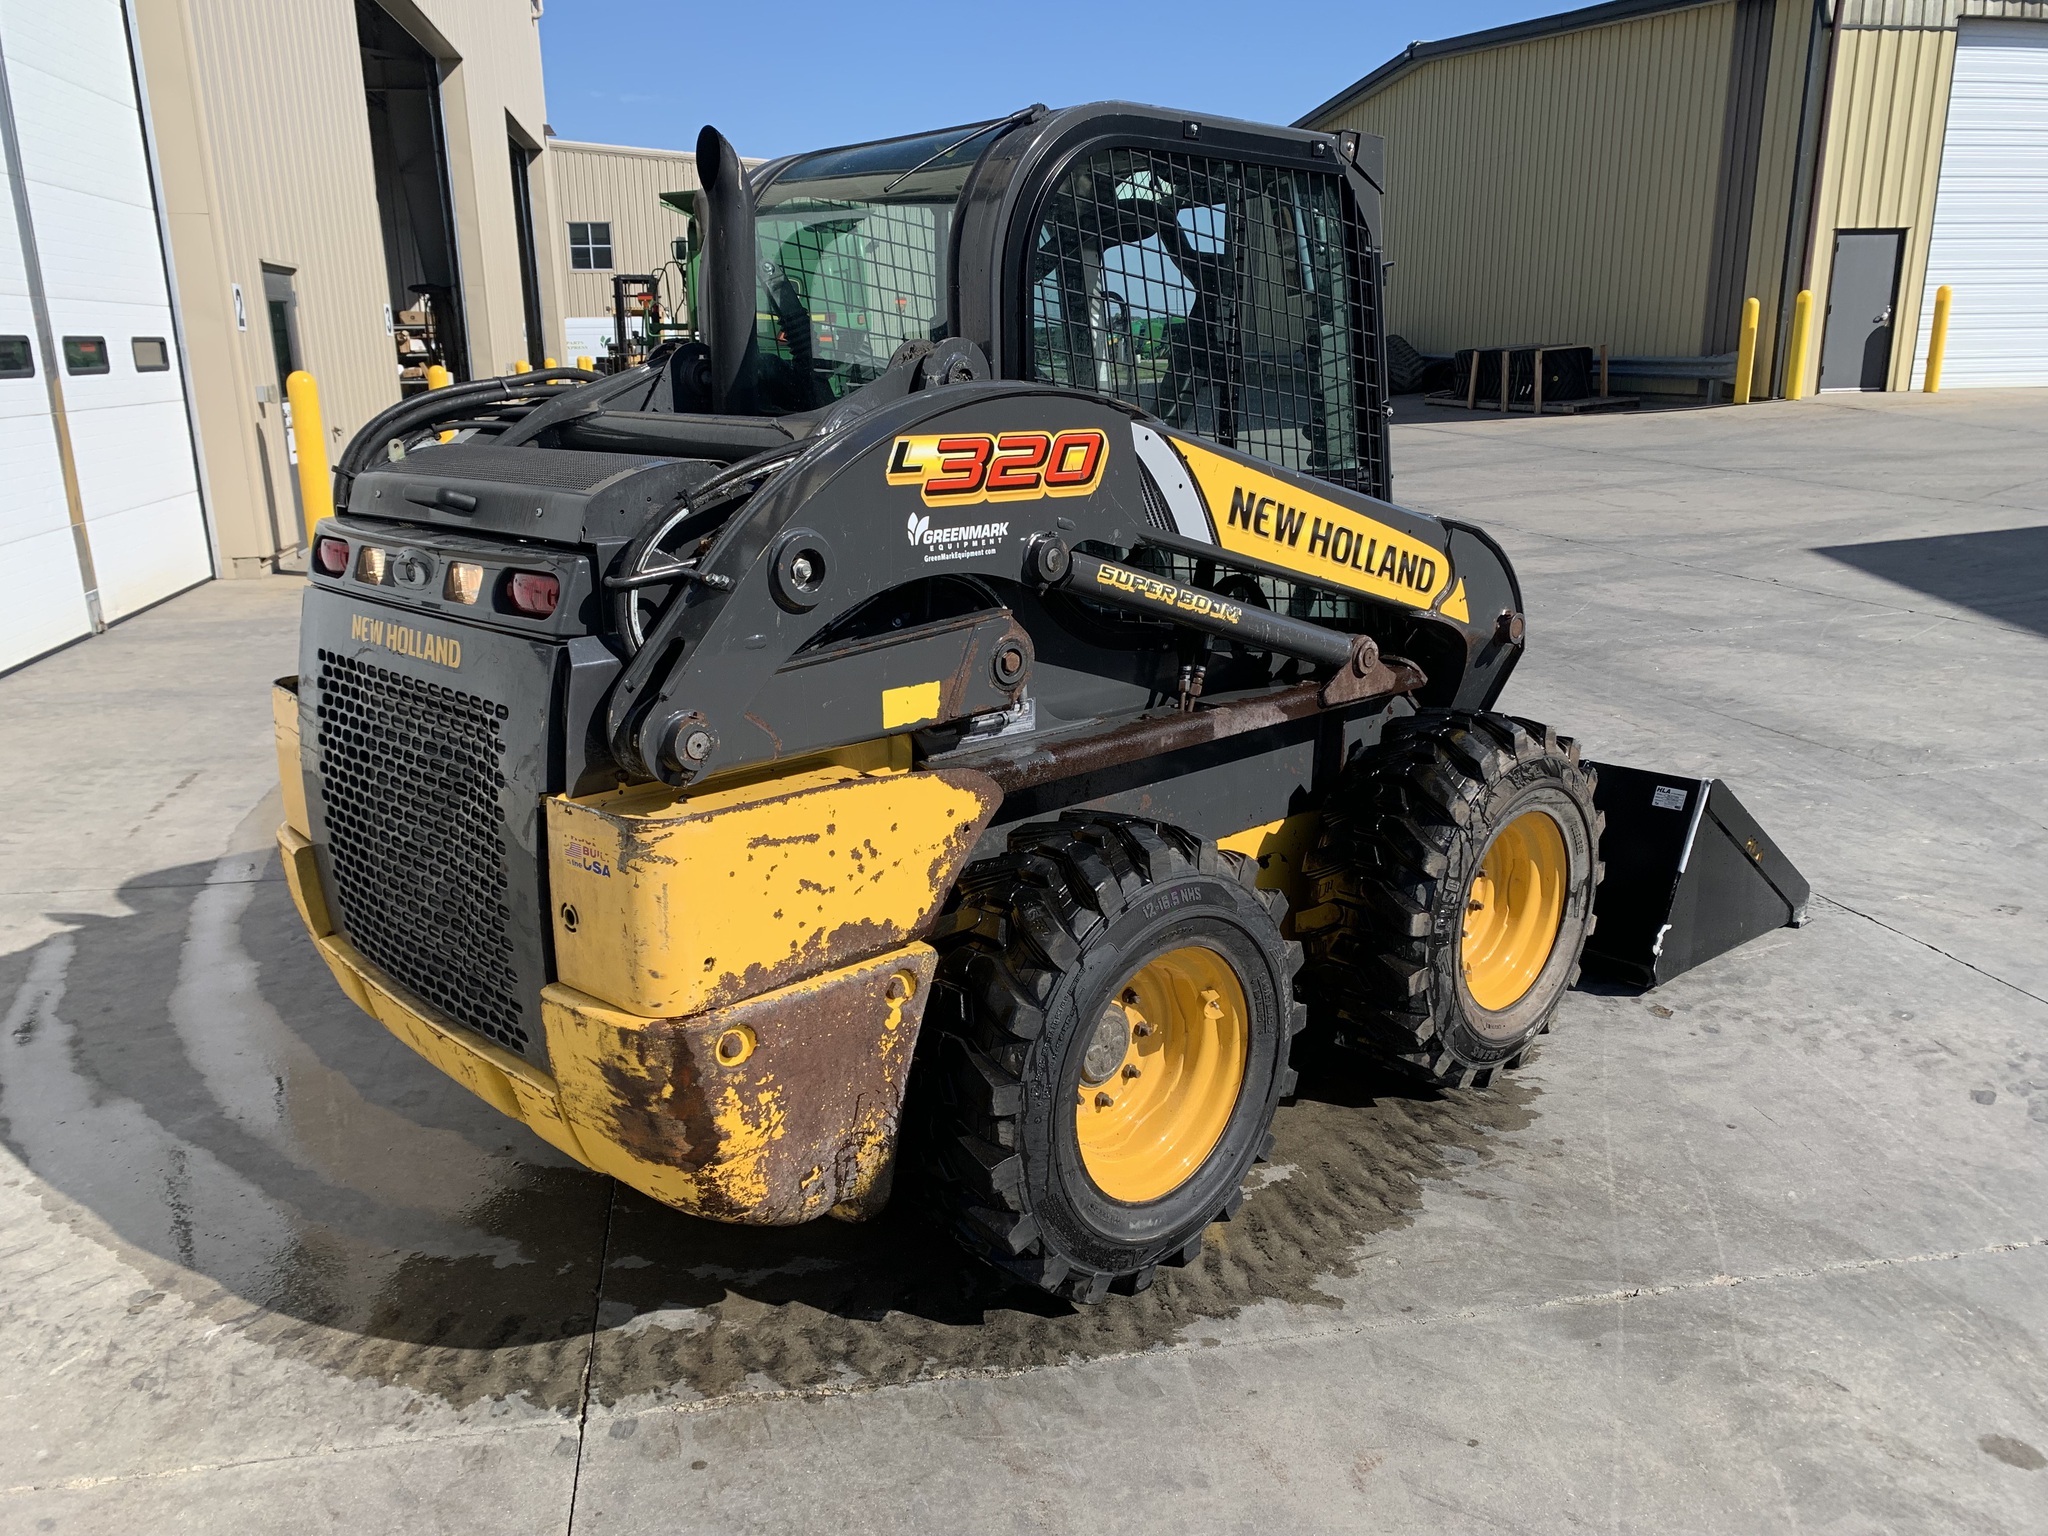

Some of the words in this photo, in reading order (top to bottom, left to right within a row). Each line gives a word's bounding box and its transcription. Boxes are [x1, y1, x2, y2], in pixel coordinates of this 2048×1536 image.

[235, 288, 246, 328] 2
[385, 306, 393, 334] 3
[887, 430, 1107, 498] L320
[922, 521, 1010, 545] GREENMARK
[929, 537, 1002, 552] EQUIPMENT
[1227, 485, 1307, 548] NEW
[1307, 516, 1437, 594] HOLLAND
[924, 548, 997, 563] GreenMarkEquipmentcom
[1097, 563, 1178, 606] SUPER
[351, 613, 384, 646] NEW
[385, 623, 462, 669] HOLLAND
[1656, 787, 1672, 795] HLA
[582, 845, 608, 863] BUIL
[582, 857, 611, 878] USA
